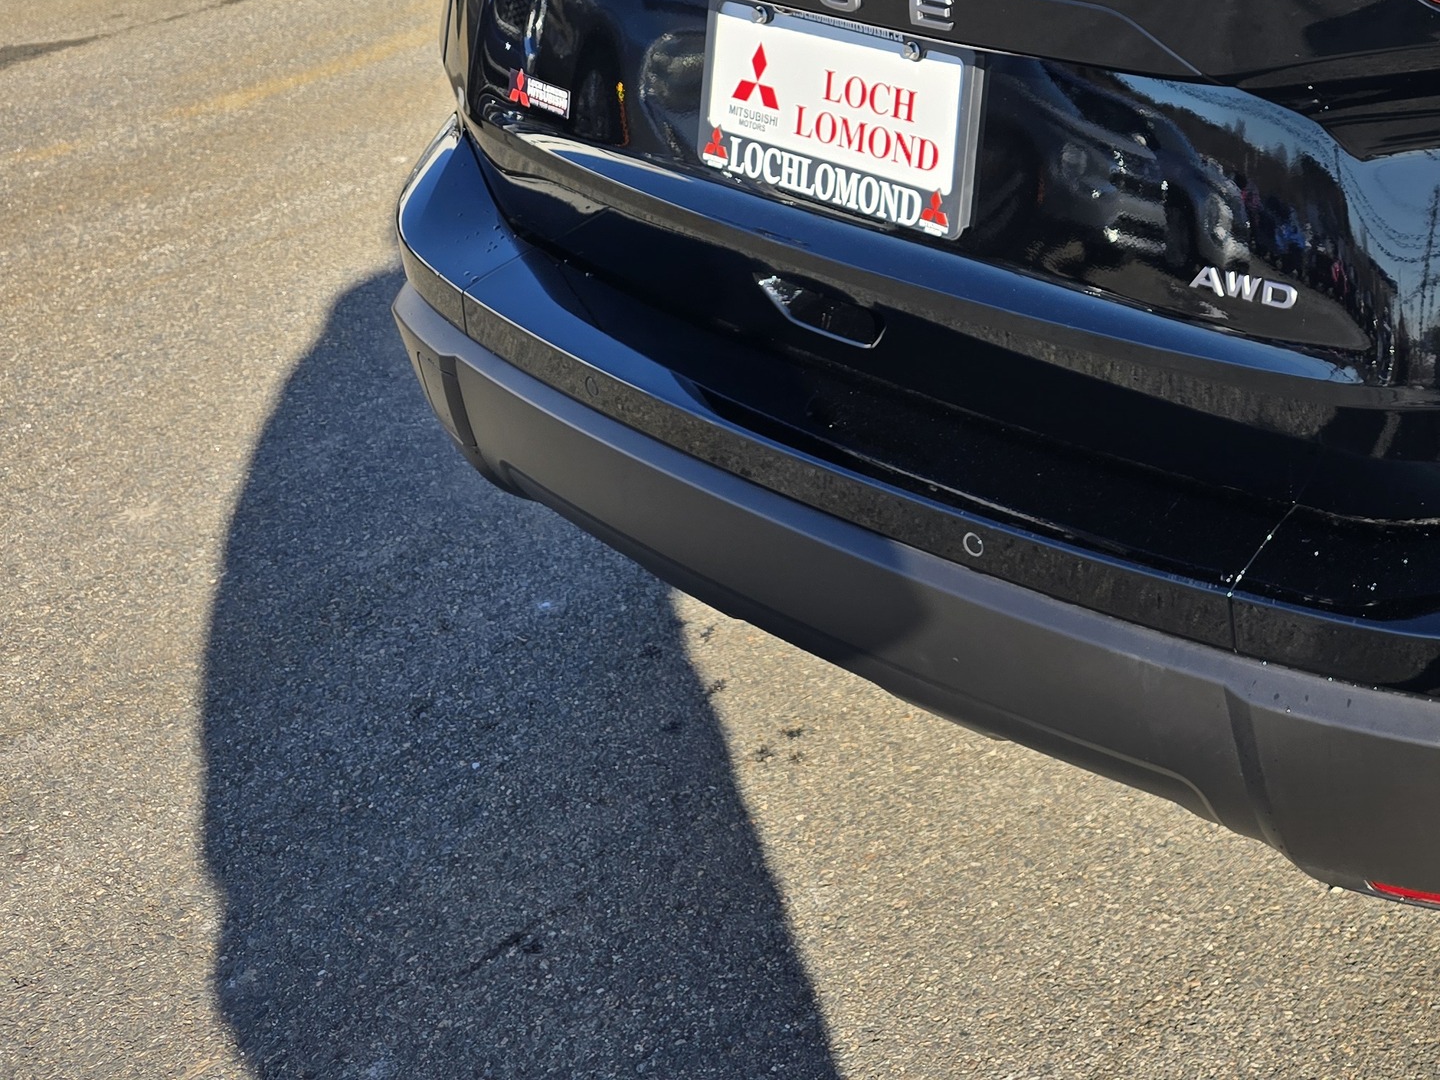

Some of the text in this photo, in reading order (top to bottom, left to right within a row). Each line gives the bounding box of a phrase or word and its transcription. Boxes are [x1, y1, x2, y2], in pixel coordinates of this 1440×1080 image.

[728, 104, 779, 127] MITSUBISHI
[822, 69, 918, 123] LOCH
[738, 118, 766, 132] MOTORS
[793, 104, 939, 171] LOMOND
[728, 136, 922, 226] LOCHLOMOND
[1188, 266, 1298, 309] AWD
